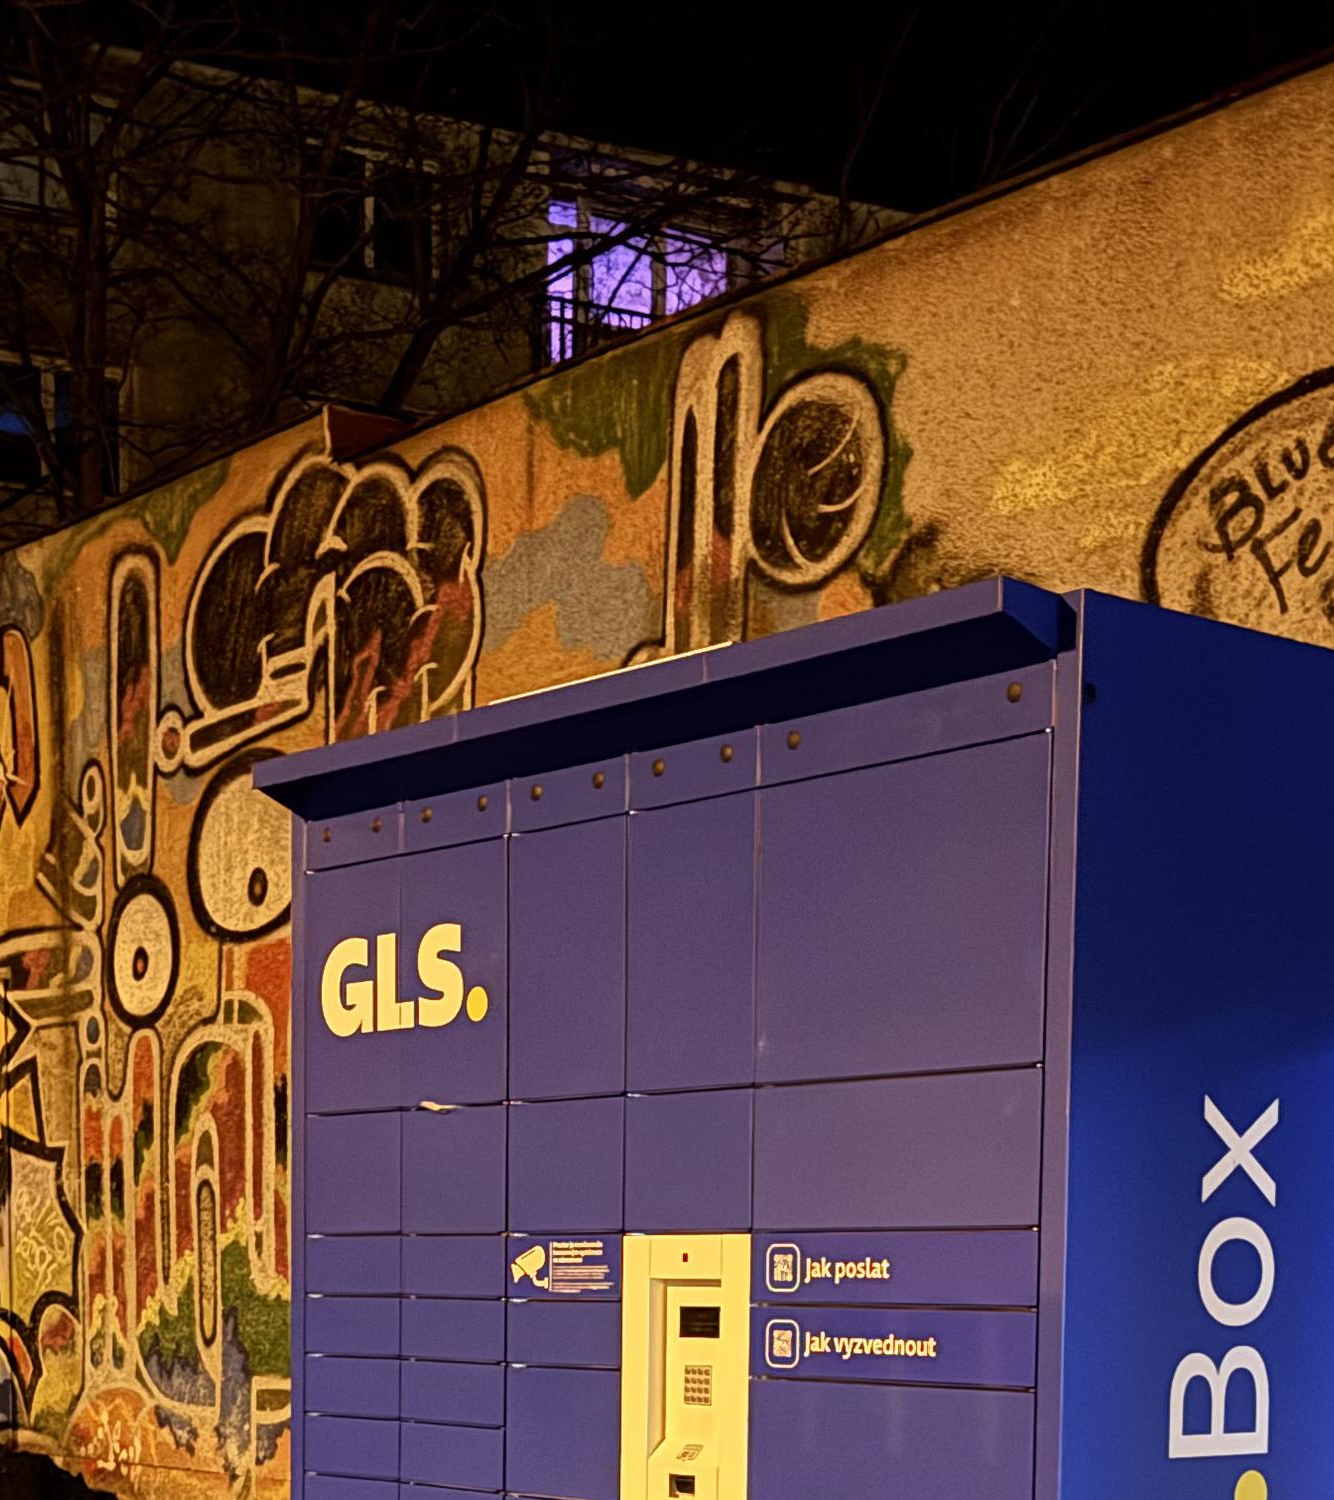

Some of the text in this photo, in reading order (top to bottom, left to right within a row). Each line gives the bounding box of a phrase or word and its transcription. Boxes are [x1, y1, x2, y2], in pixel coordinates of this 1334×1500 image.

[321, 922, 488, 1038] GLS.
[804, 1257, 890, 1285] Jak poslat
[803, 1331, 937, 1360] Jak vyzvednout
